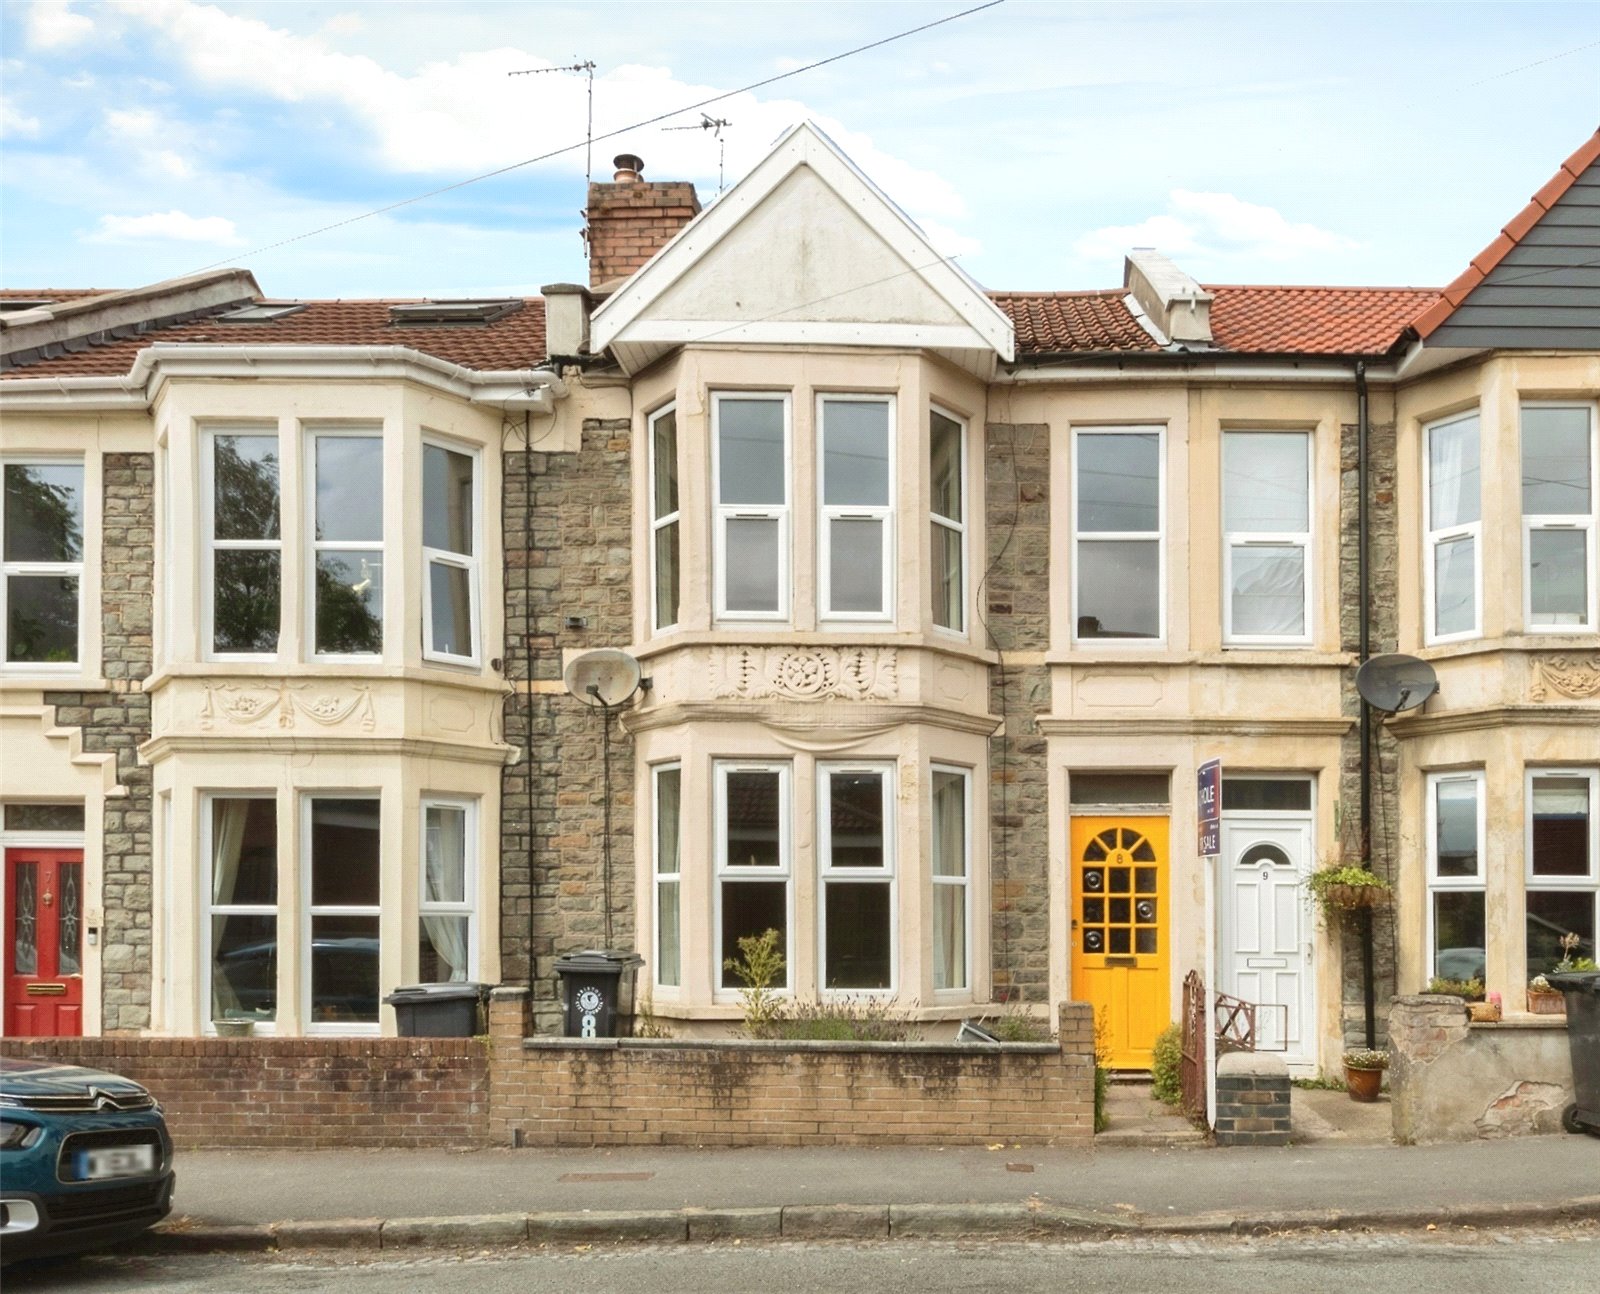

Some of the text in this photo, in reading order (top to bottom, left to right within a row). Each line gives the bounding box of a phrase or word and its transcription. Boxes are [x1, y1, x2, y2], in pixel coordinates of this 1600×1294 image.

[1203, 834, 1216, 849] SALE
[1116, 853, 1123, 864] 8
[45, 871, 52, 883] 7
[1262, 871, 1269, 881] 9
[576, 986, 602, 997] BRISTOL
[582, 1015, 596, 1038] 8
